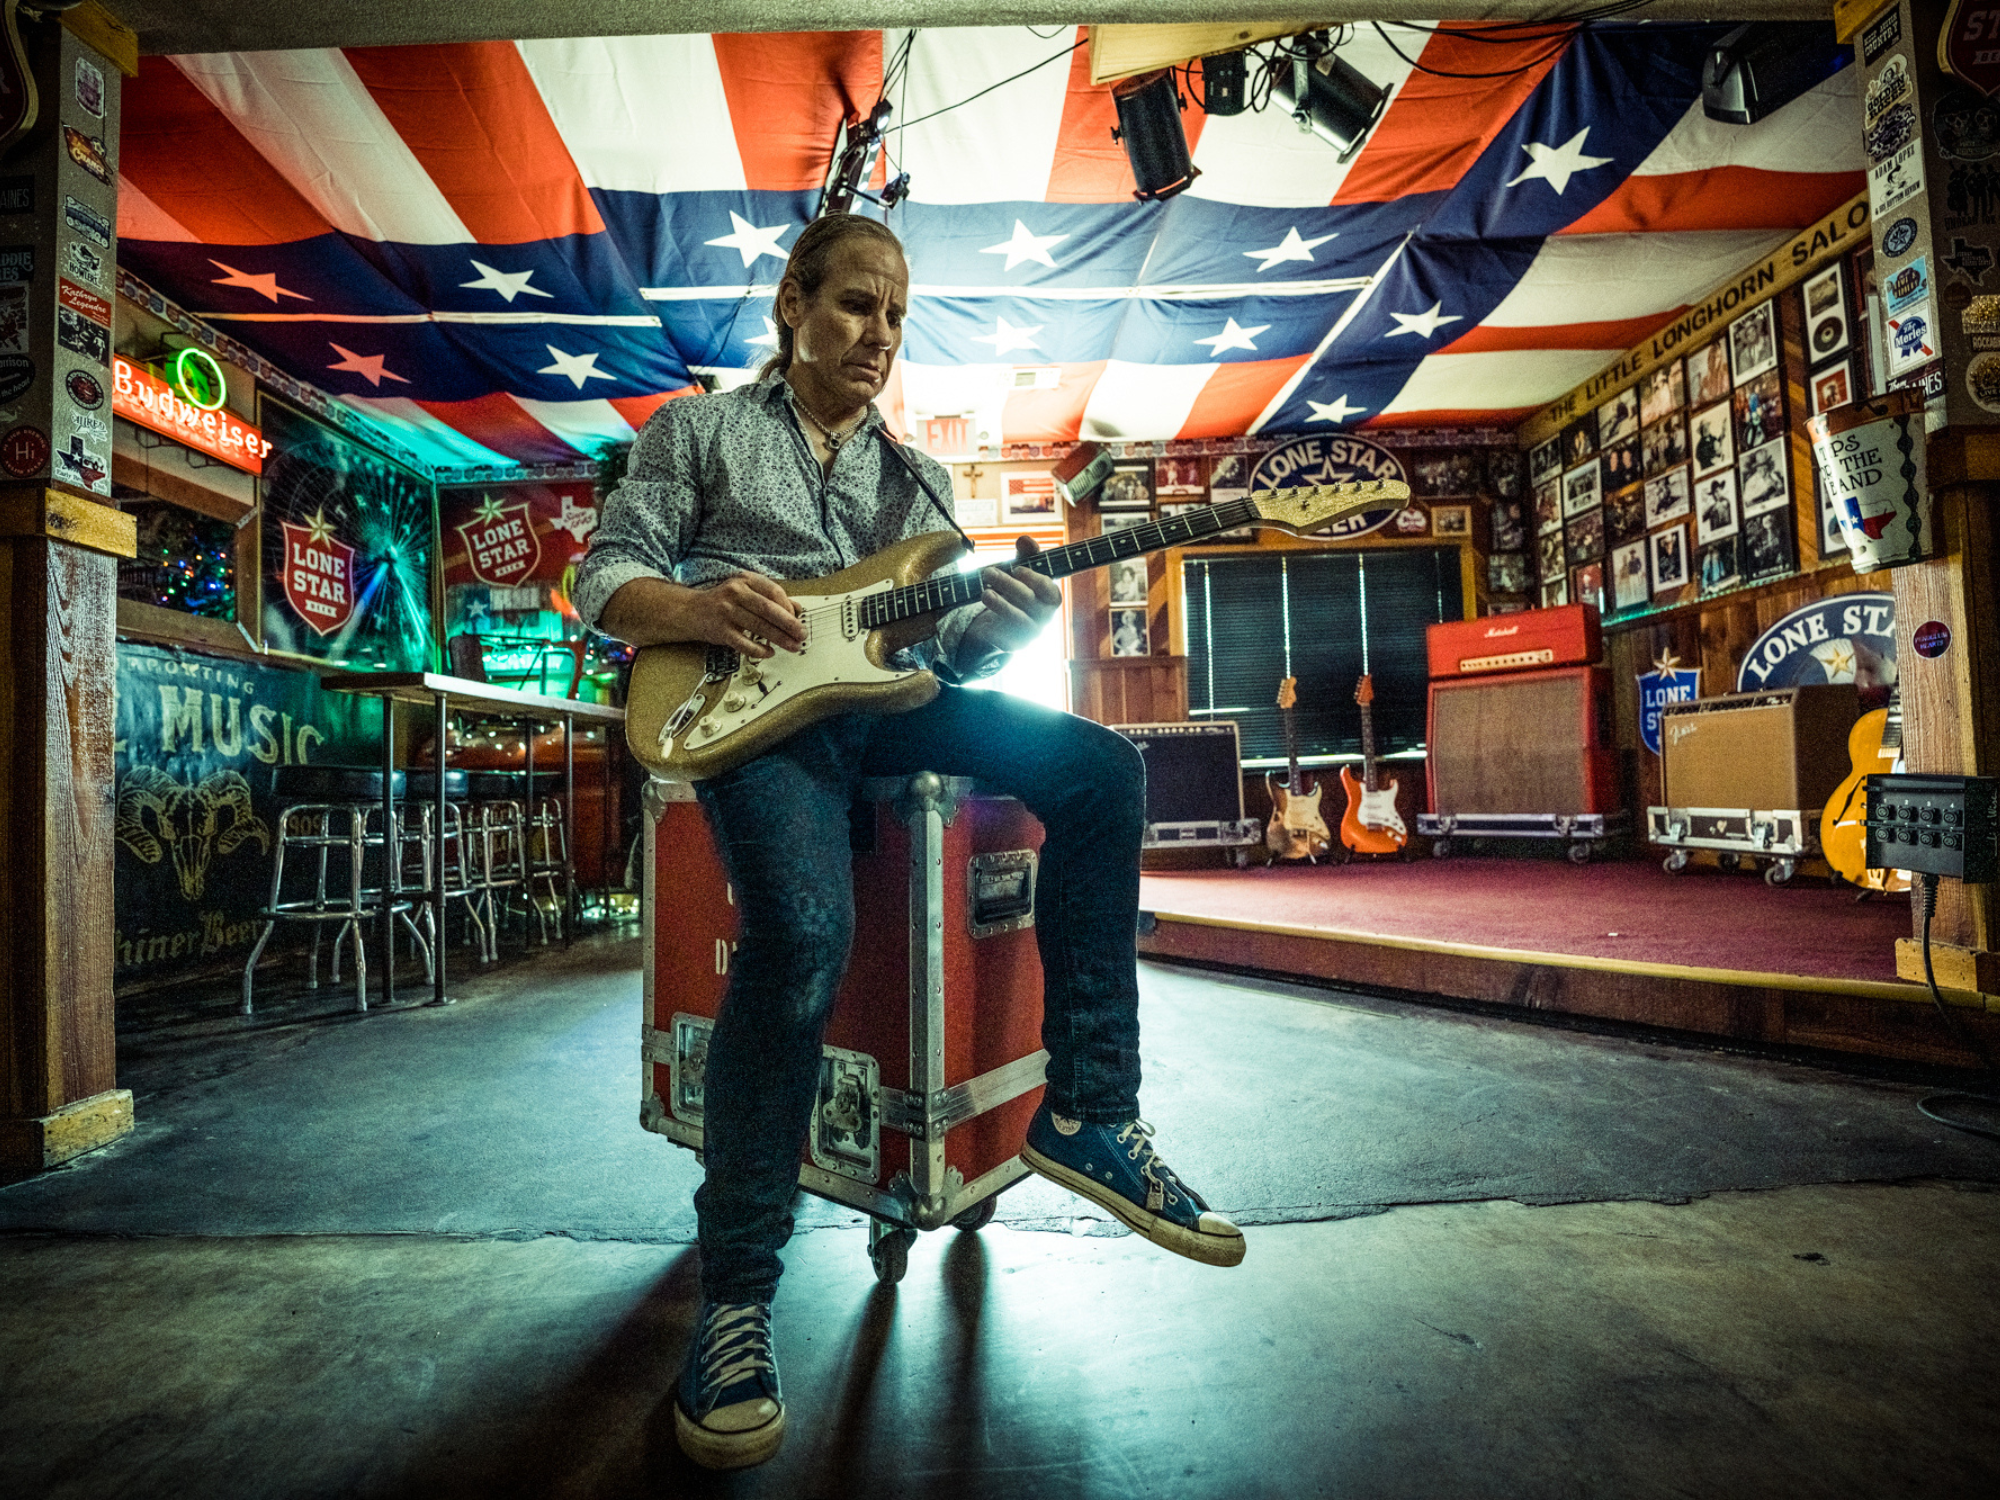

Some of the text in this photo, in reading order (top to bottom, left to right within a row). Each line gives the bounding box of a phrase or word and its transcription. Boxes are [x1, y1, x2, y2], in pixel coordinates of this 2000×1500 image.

[1864, 21, 1899, 57] COUNTRY
[1867, 73, 1905, 111] GOLDEN
[1874, 143, 1916, 180] ADAM LOPEZ
[61, 285, 98, 303] Kathryn
[69, 296, 107, 314] Legendre
[1550, 399, 1577, 423] THE
[1585, 351, 1645, 401] LITTLE
[1651, 261, 1776, 360] LONGHORN
[1895, 324, 1927, 348] Merles
[1903, 321, 1917, 334] The
[114, 359, 273, 459] Budweiser
[926, 418, 969, 451] EXIT
[1819, 434, 1861, 461] TPS
[15, 441, 35, 461] Hi
[1255, 439, 1398, 489] LONE STAR
[1839, 447, 1883, 473] THE
[1829, 468, 1883, 497] BAND
[471, 519, 524, 551] LONE
[293, 542, 345, 580] LONE
[478, 538, 530, 570] STAR
[293, 569, 346, 604] STAR
[1747, 612, 1829, 684] LONE
[1645, 684, 1692, 708] LONE
[158, 684, 326, 766] MUSIC
